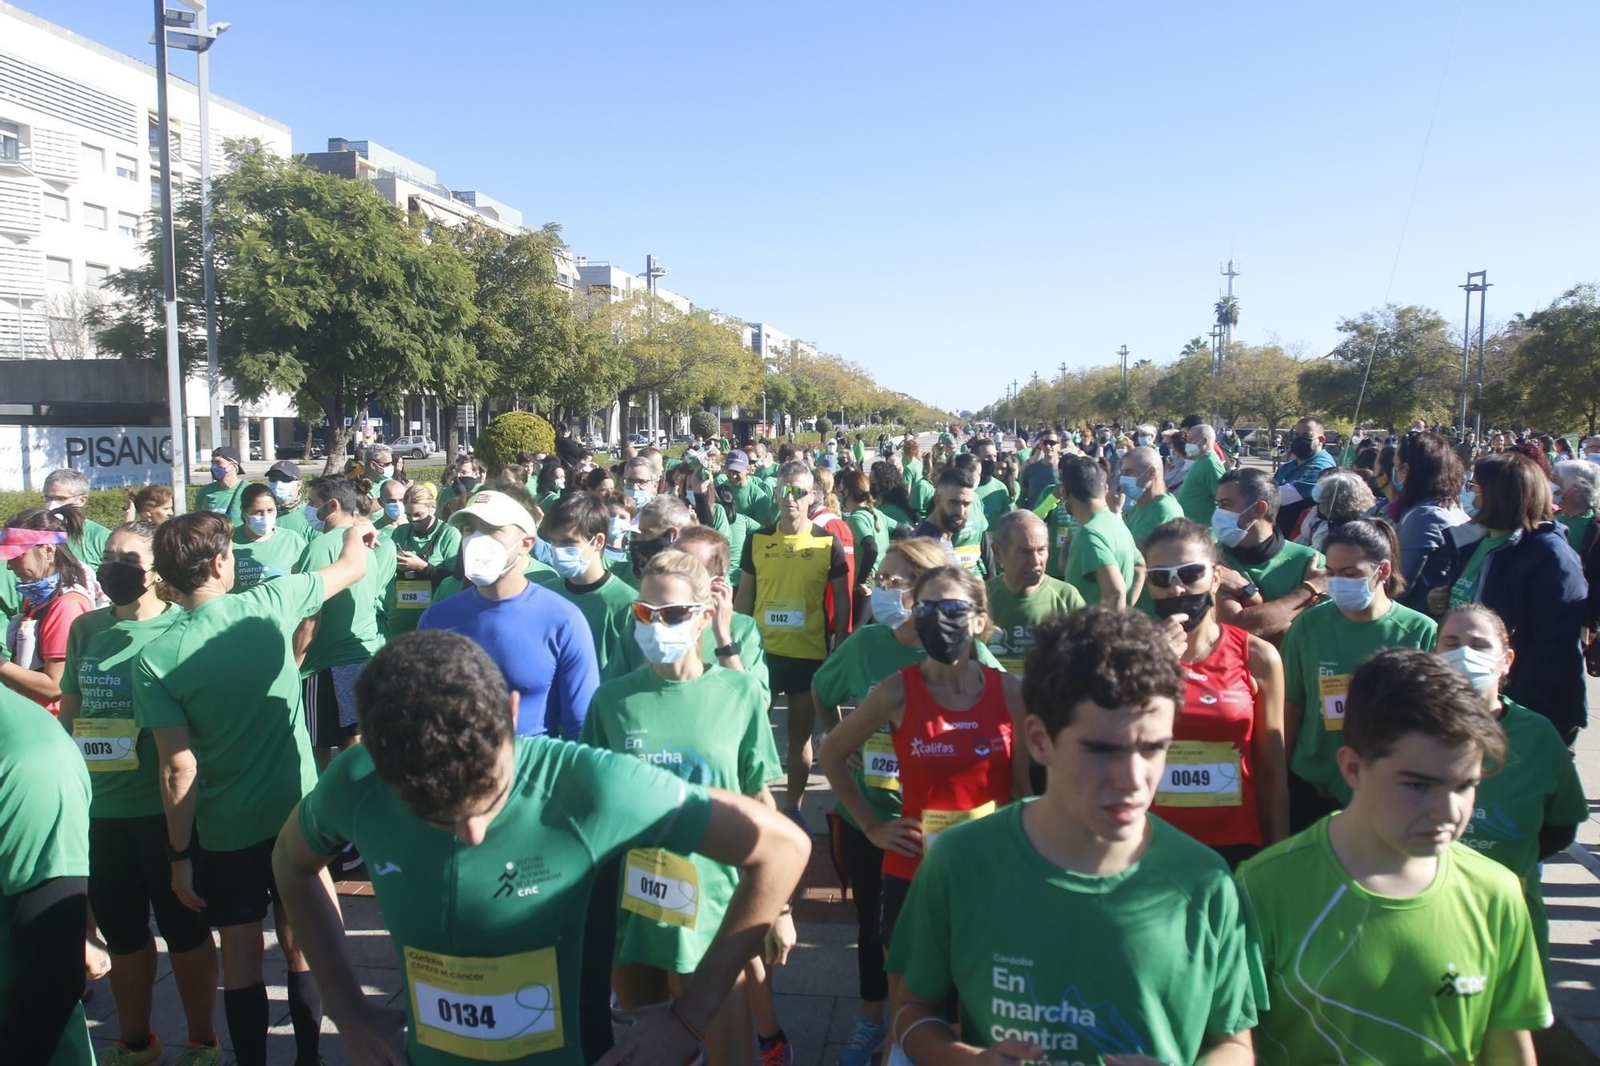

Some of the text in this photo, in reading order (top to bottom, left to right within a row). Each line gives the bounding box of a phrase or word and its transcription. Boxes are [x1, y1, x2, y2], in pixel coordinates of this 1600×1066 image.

[770, 614, 789, 622] 0142
[1319, 666, 1334, 677] En
[84, 742, 113, 756] 0073
[624, 737, 643, 750] En
[920, 743, 954, 754] califas
[638, 749, 682, 764] archa
[1171, 770, 1211, 787] 0049
[641, 877, 668, 900] 0147
[410, 961, 439, 975] contra
[992, 967, 1026, 994] En
[437, 998, 496, 1030] 0134
[991, 997, 1097, 1028] marcha
